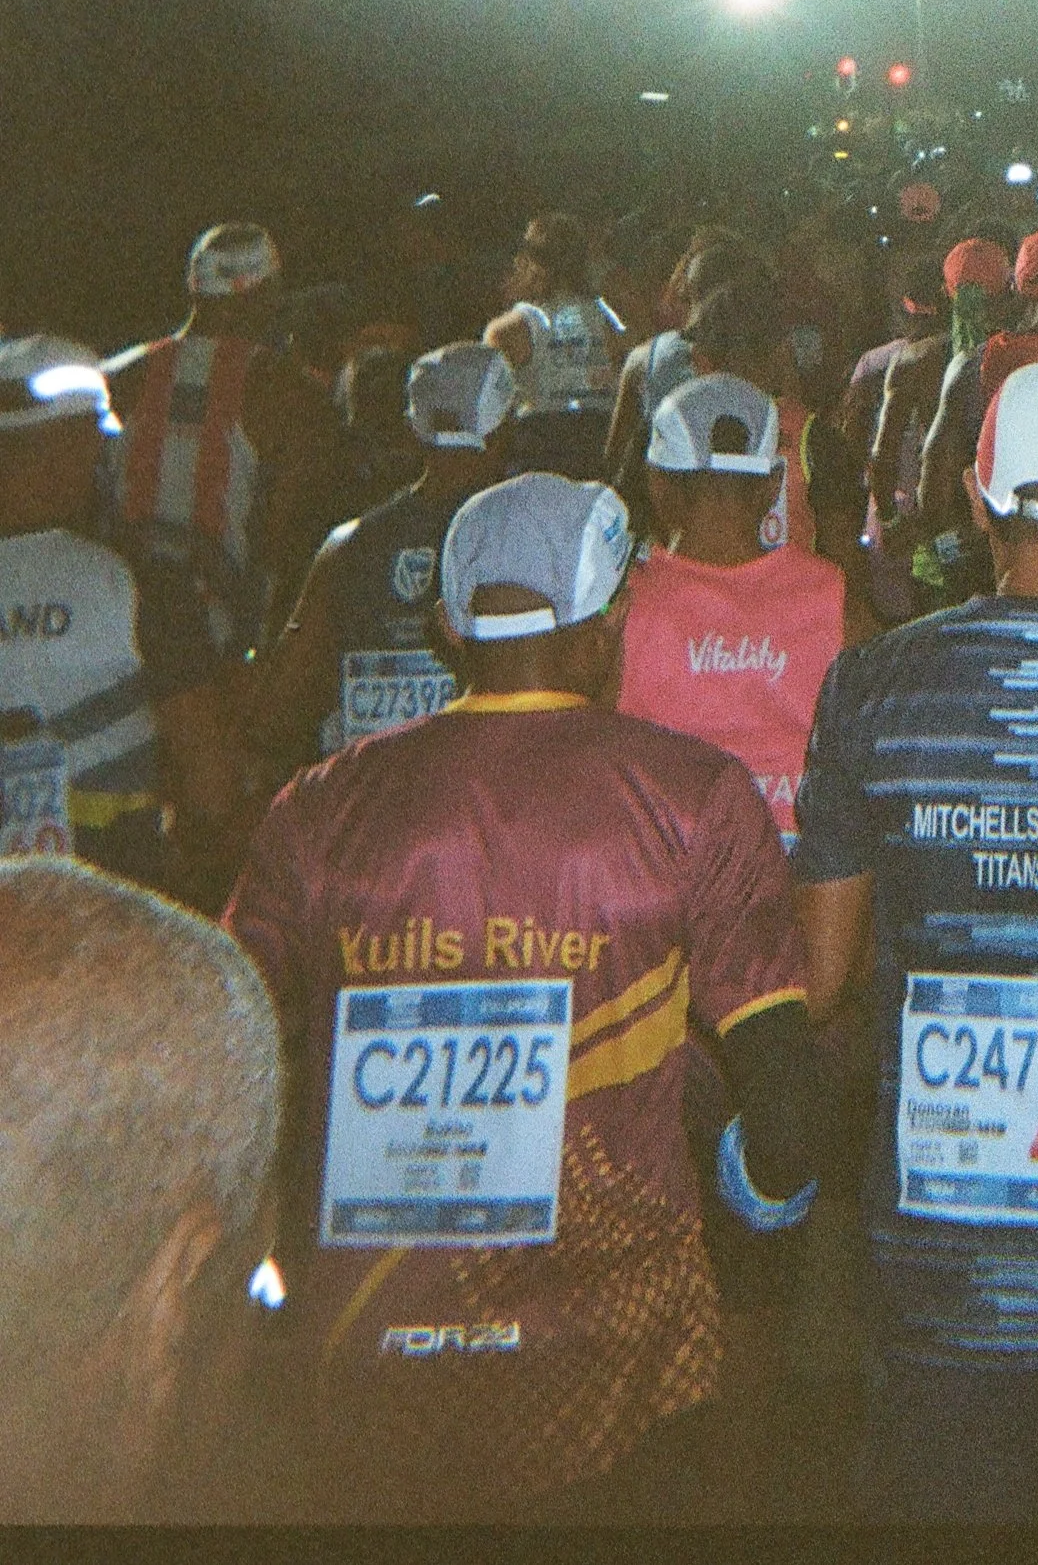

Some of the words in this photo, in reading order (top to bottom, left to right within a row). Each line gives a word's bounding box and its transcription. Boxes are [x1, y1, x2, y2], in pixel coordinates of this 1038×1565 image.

[0, 601, 73, 637] ND
[688, 630, 788, 684] Vitality
[339, 915, 465, 975] Kuils
[485, 915, 612, 973] River
[355, 1035, 553, 1110] C21225
